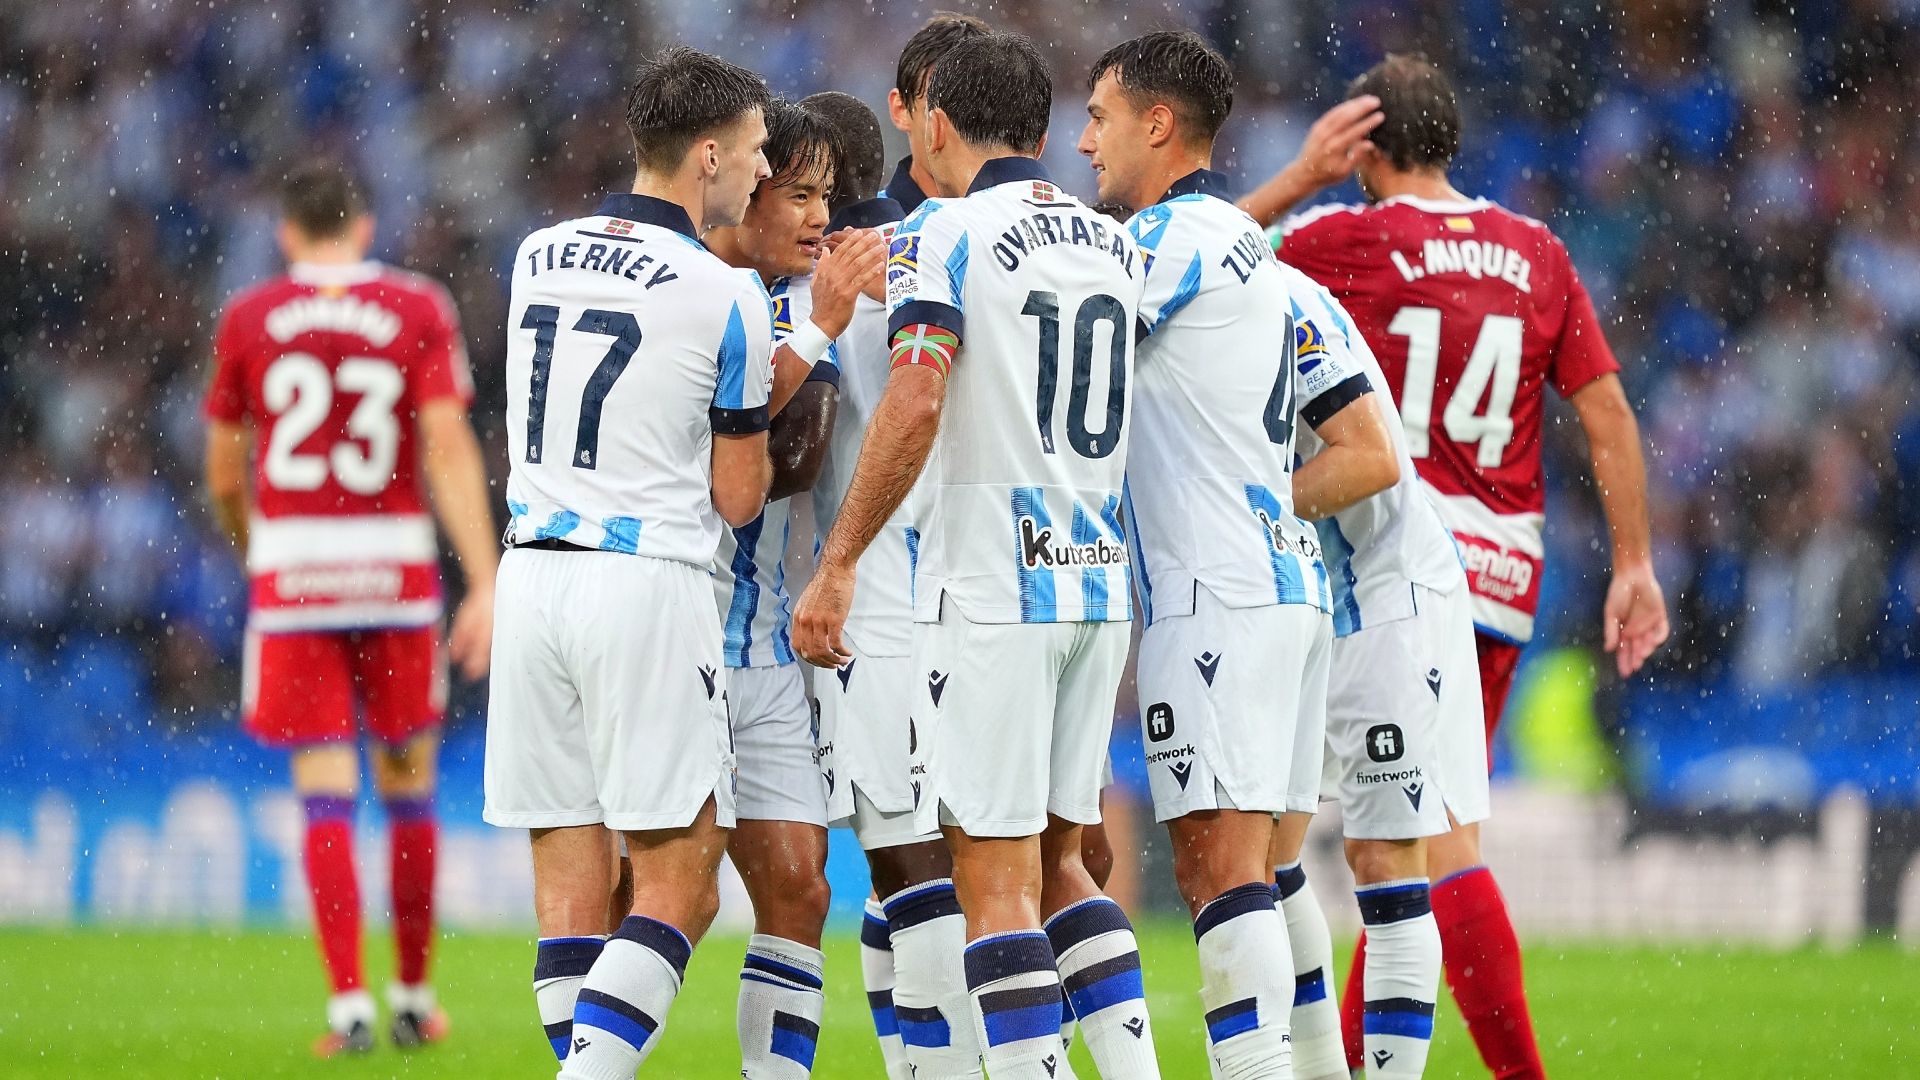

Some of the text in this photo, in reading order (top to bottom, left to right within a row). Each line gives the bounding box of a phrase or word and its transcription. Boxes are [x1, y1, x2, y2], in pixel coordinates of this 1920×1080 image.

[528, 243, 679, 290] TIERNEY
[992, 213, 1133, 280] OYARZABAL
[1423, 238, 1532, 293] MIQUEL
[520, 304, 643, 470] 17
[1021, 290, 1126, 459] 10
[1263, 312, 1296, 473] 4
[1306, 361, 1337, 387] REALE
[1388, 307, 1523, 467] 14
[262, 352, 404, 494] 23
[1022, 519, 1128, 567] Kutxaban
[1457, 541, 1533, 596] ening
[1356, 765, 1422, 784] finetwork
